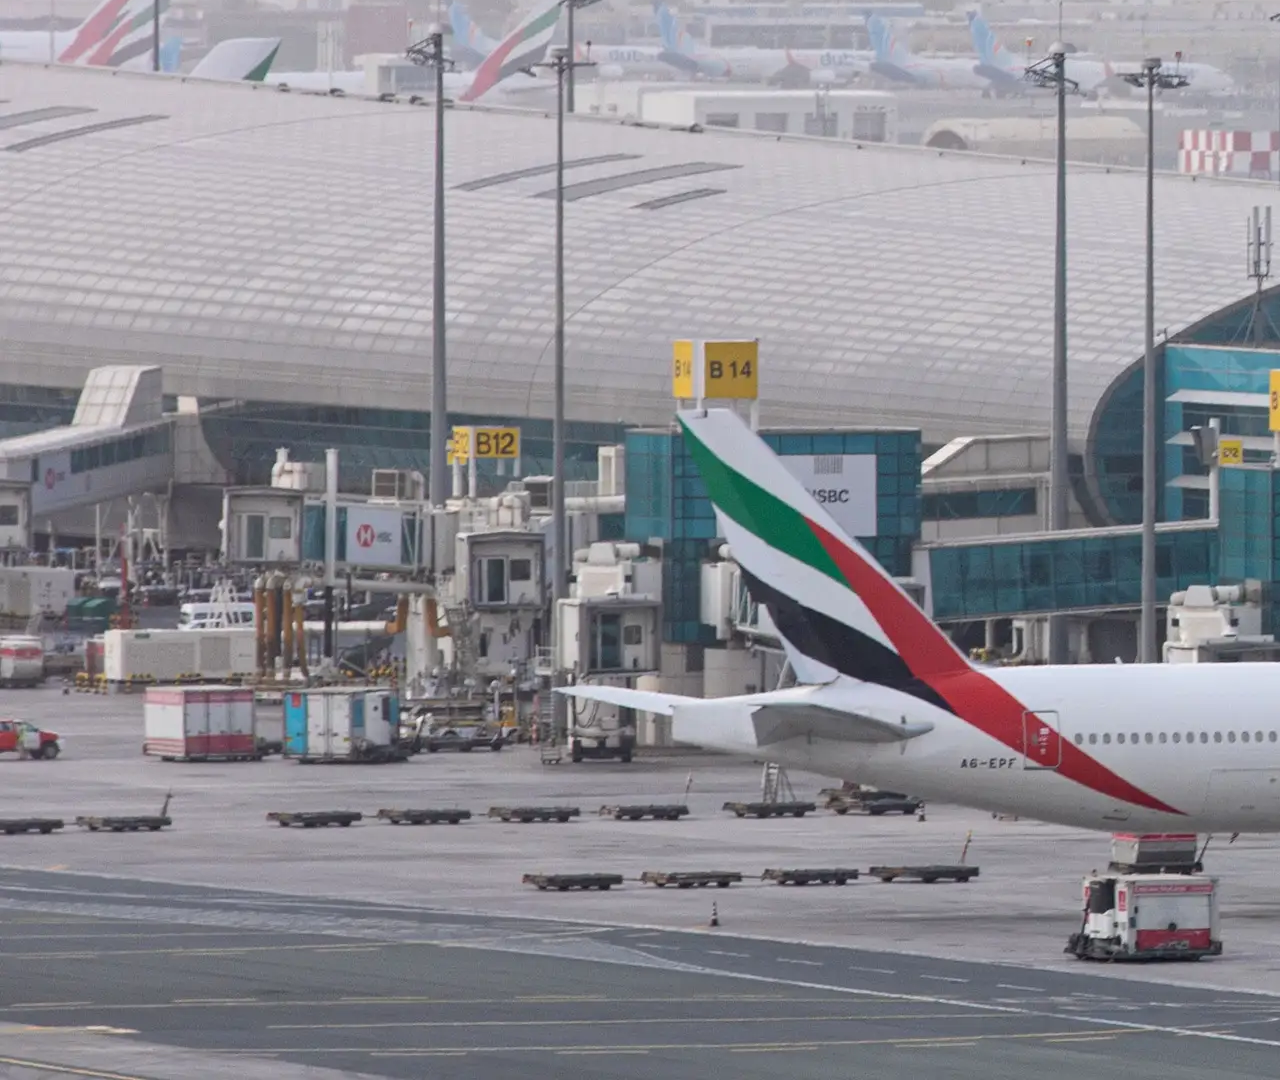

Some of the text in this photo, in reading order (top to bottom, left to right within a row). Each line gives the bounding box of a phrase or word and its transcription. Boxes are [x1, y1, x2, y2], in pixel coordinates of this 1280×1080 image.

[710, 360, 752, 379] B 14
[1271, 391, 1278, 410] B
[476, 432, 515, 455] B12
[960, 757, 1017, 769] A6-EPF
